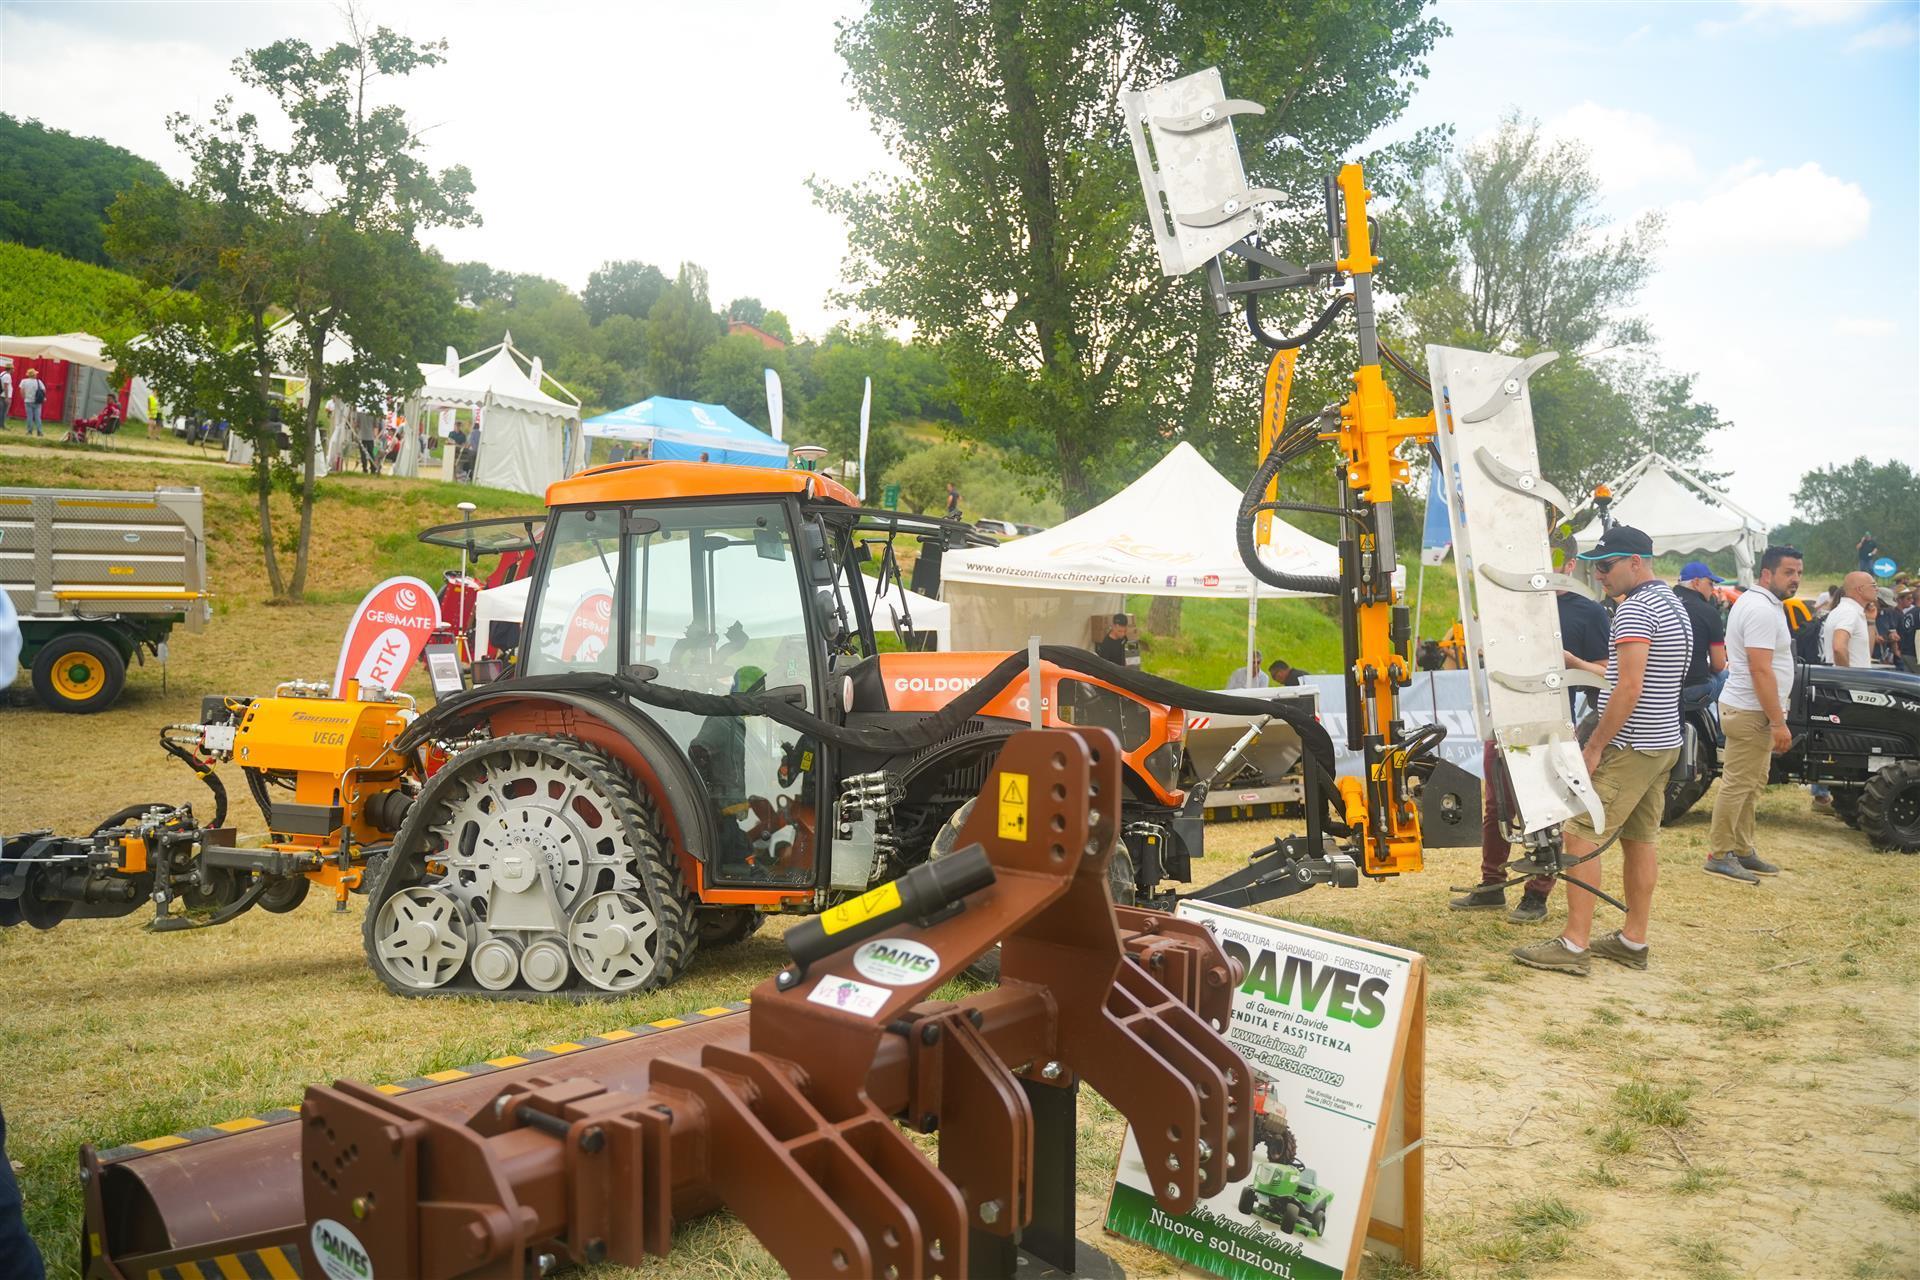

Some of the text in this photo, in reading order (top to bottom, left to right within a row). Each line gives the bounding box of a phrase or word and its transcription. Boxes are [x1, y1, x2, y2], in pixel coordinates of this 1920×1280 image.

[966, 562, 1151, 584] www.orizzontimacchineagricole.it
[366, 610, 431, 629] GEOMATE
[370, 637, 401, 684] RTK
[894, 675, 983, 692] GOLDON
[1856, 694, 1877, 703] 930
[313, 732, 345, 746] VEGA
[870, 945, 935, 973] DAIVES
[1222, 927, 1393, 979] AGRICOLTURA GIARDINAGGIO FORESTAZIONE
[1230, 1009, 1352, 1053] ENDITA E ASSISTENZA
[1245, 1000, 1329, 1032] di Guerrini Davide
[1231, 1026, 1308, 1059] www.daives.it
[323, 1229, 369, 1278] DAIVES
[1149, 1206, 1205, 1244] Nuove
[1208, 1236, 1296, 1280] soluzioni.
